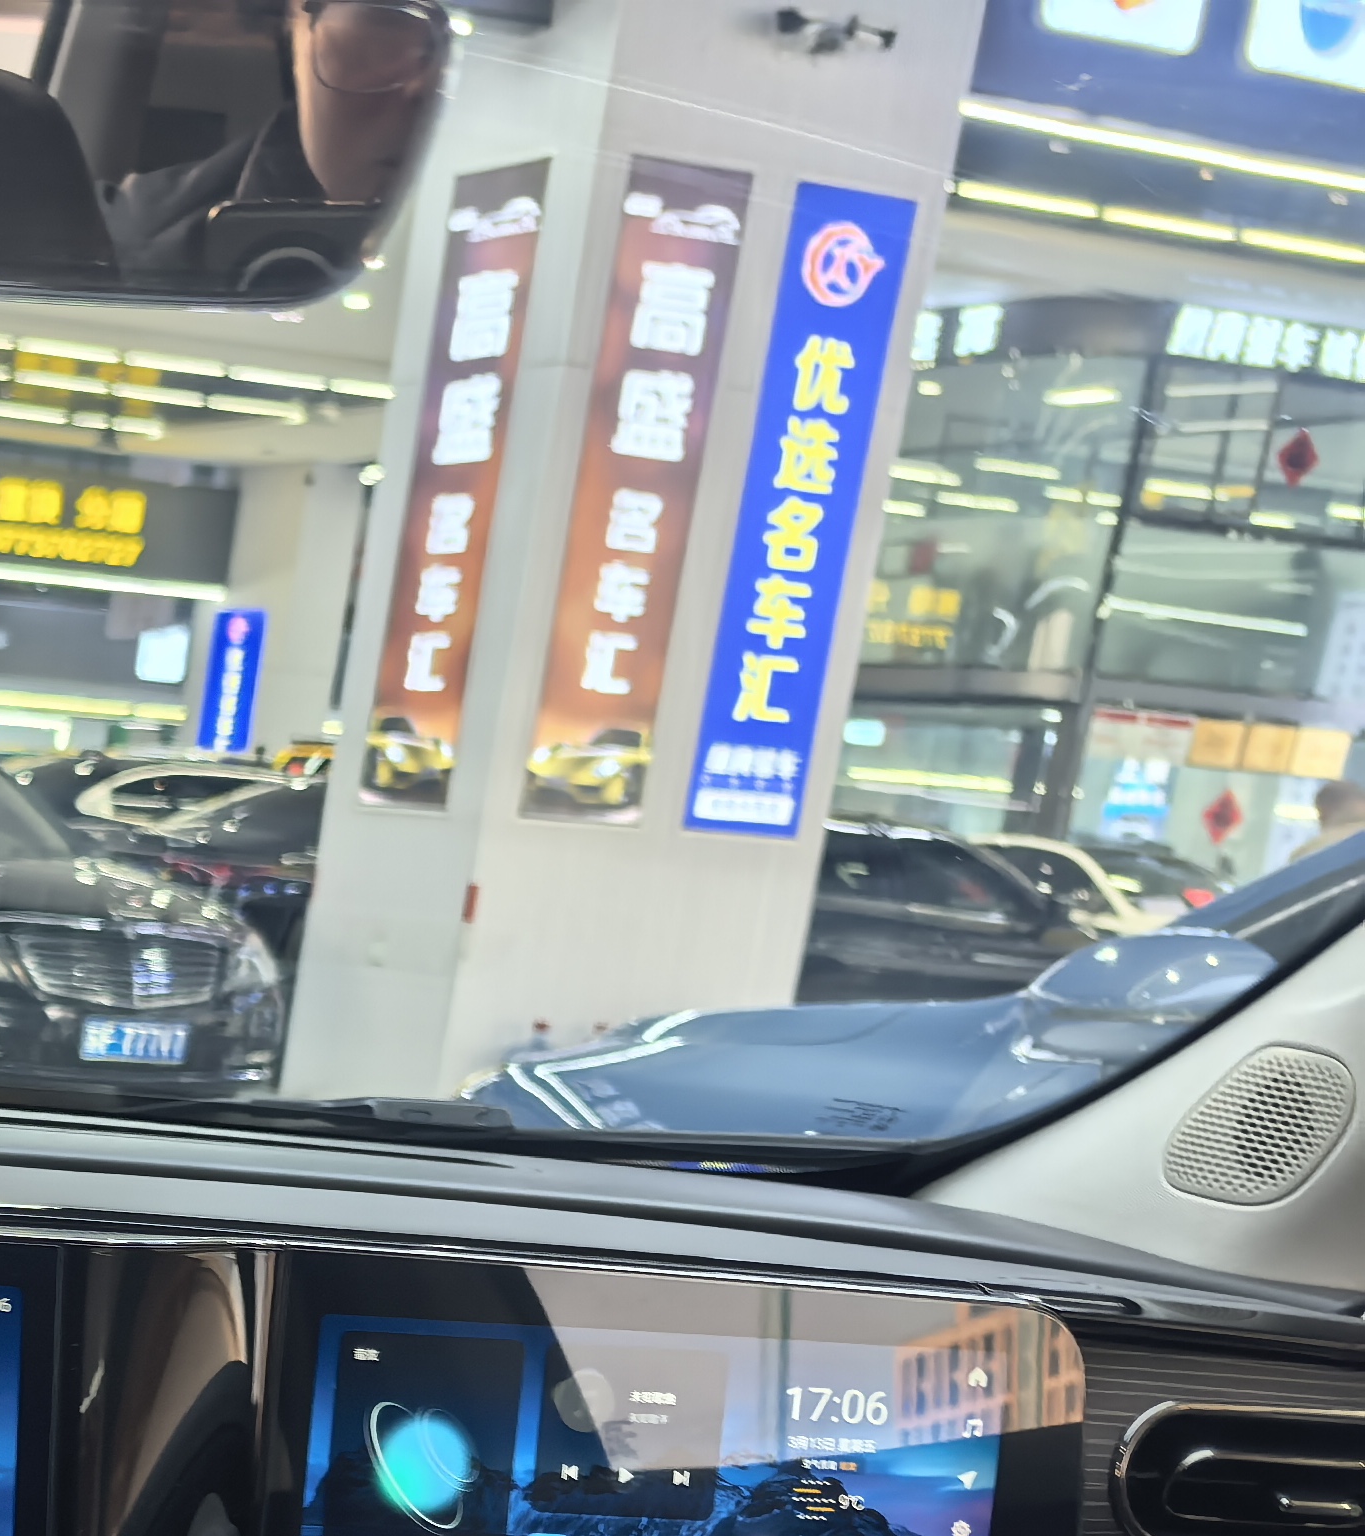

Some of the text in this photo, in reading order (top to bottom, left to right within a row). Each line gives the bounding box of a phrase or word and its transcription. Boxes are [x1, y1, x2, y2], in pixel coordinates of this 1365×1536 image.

[580, 259, 716, 696] 高盛名车汇
[732, 334, 857, 725] 优选名车汇
[786, 1385, 888, 1426] 17:06
